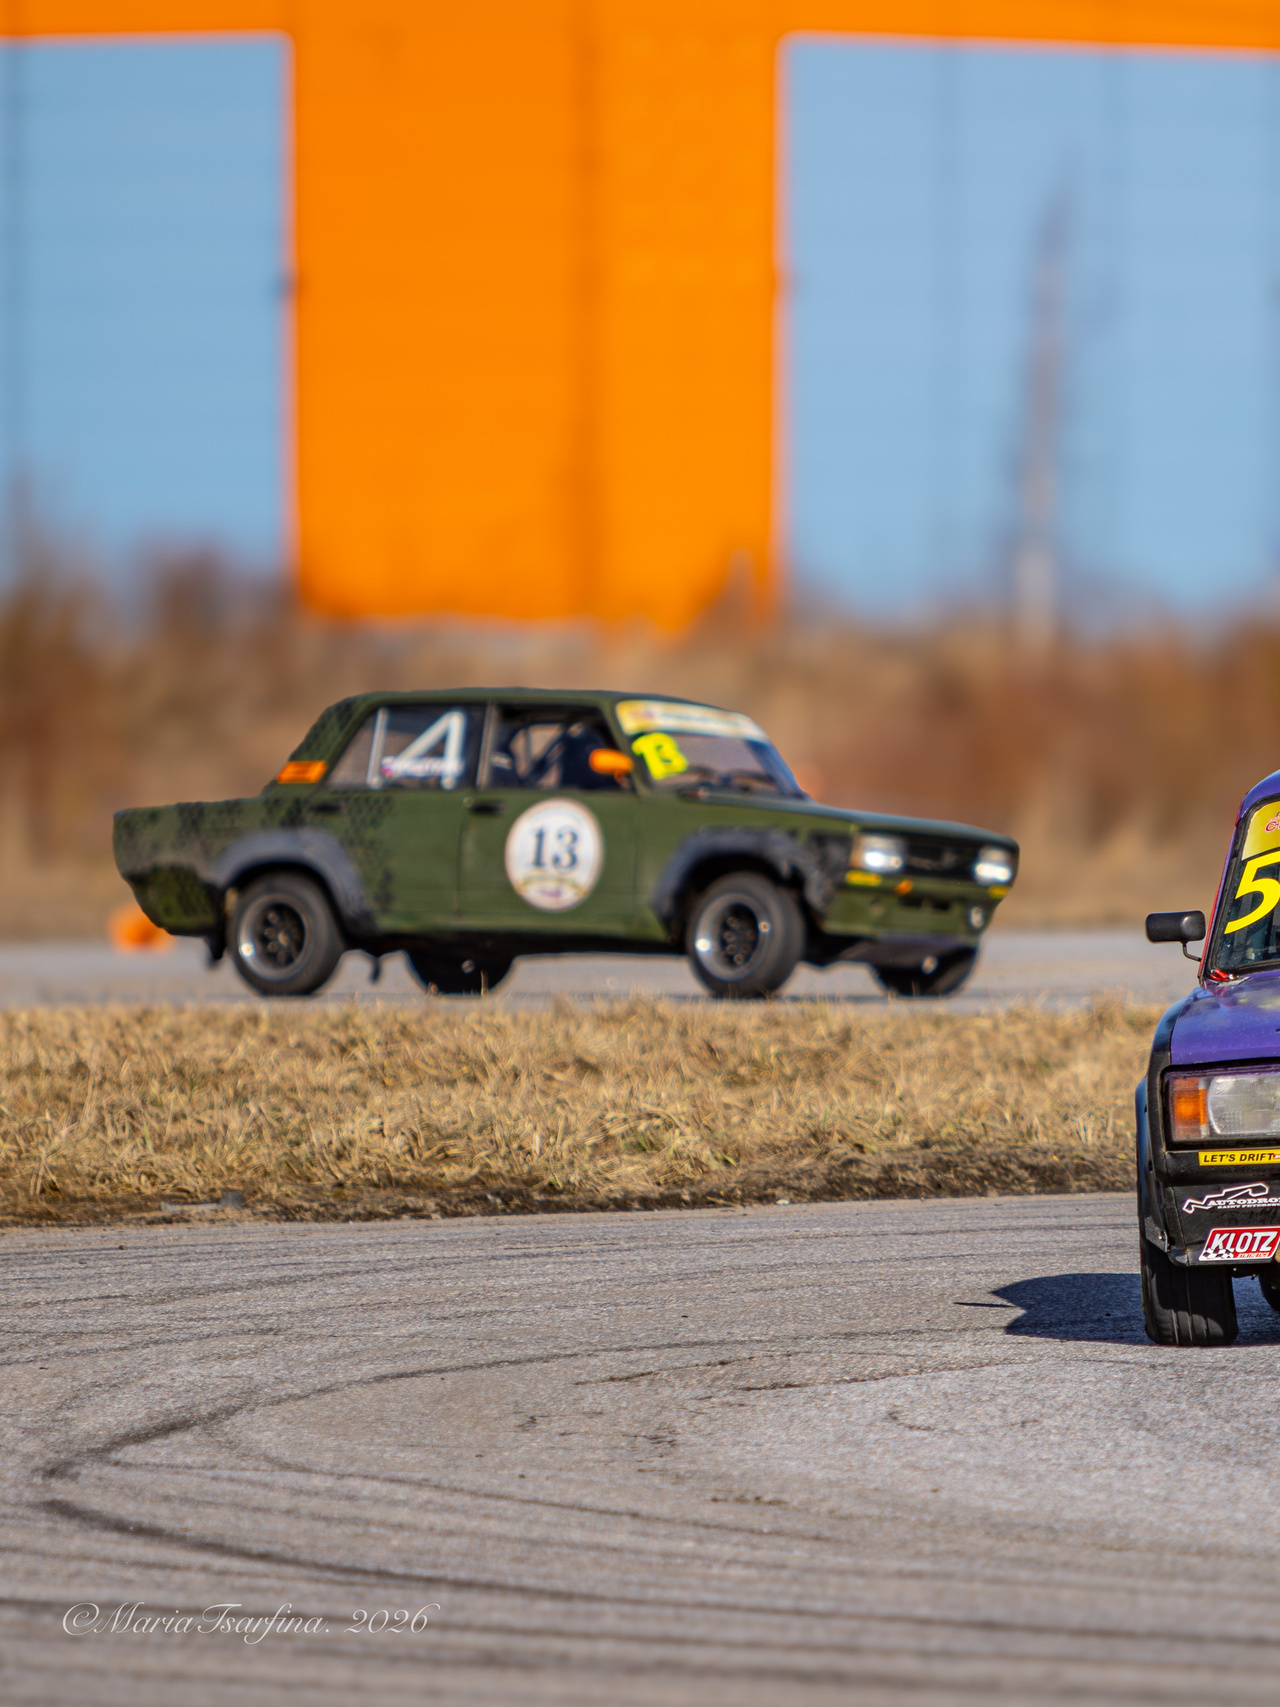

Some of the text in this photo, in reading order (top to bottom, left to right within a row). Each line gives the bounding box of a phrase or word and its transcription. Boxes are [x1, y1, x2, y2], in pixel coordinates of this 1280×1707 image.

[529, 825, 580, 874] 13
[1203, 1153, 1236, 1163] LET'S
[1210, 1231, 1278, 1253] KLOTZ
